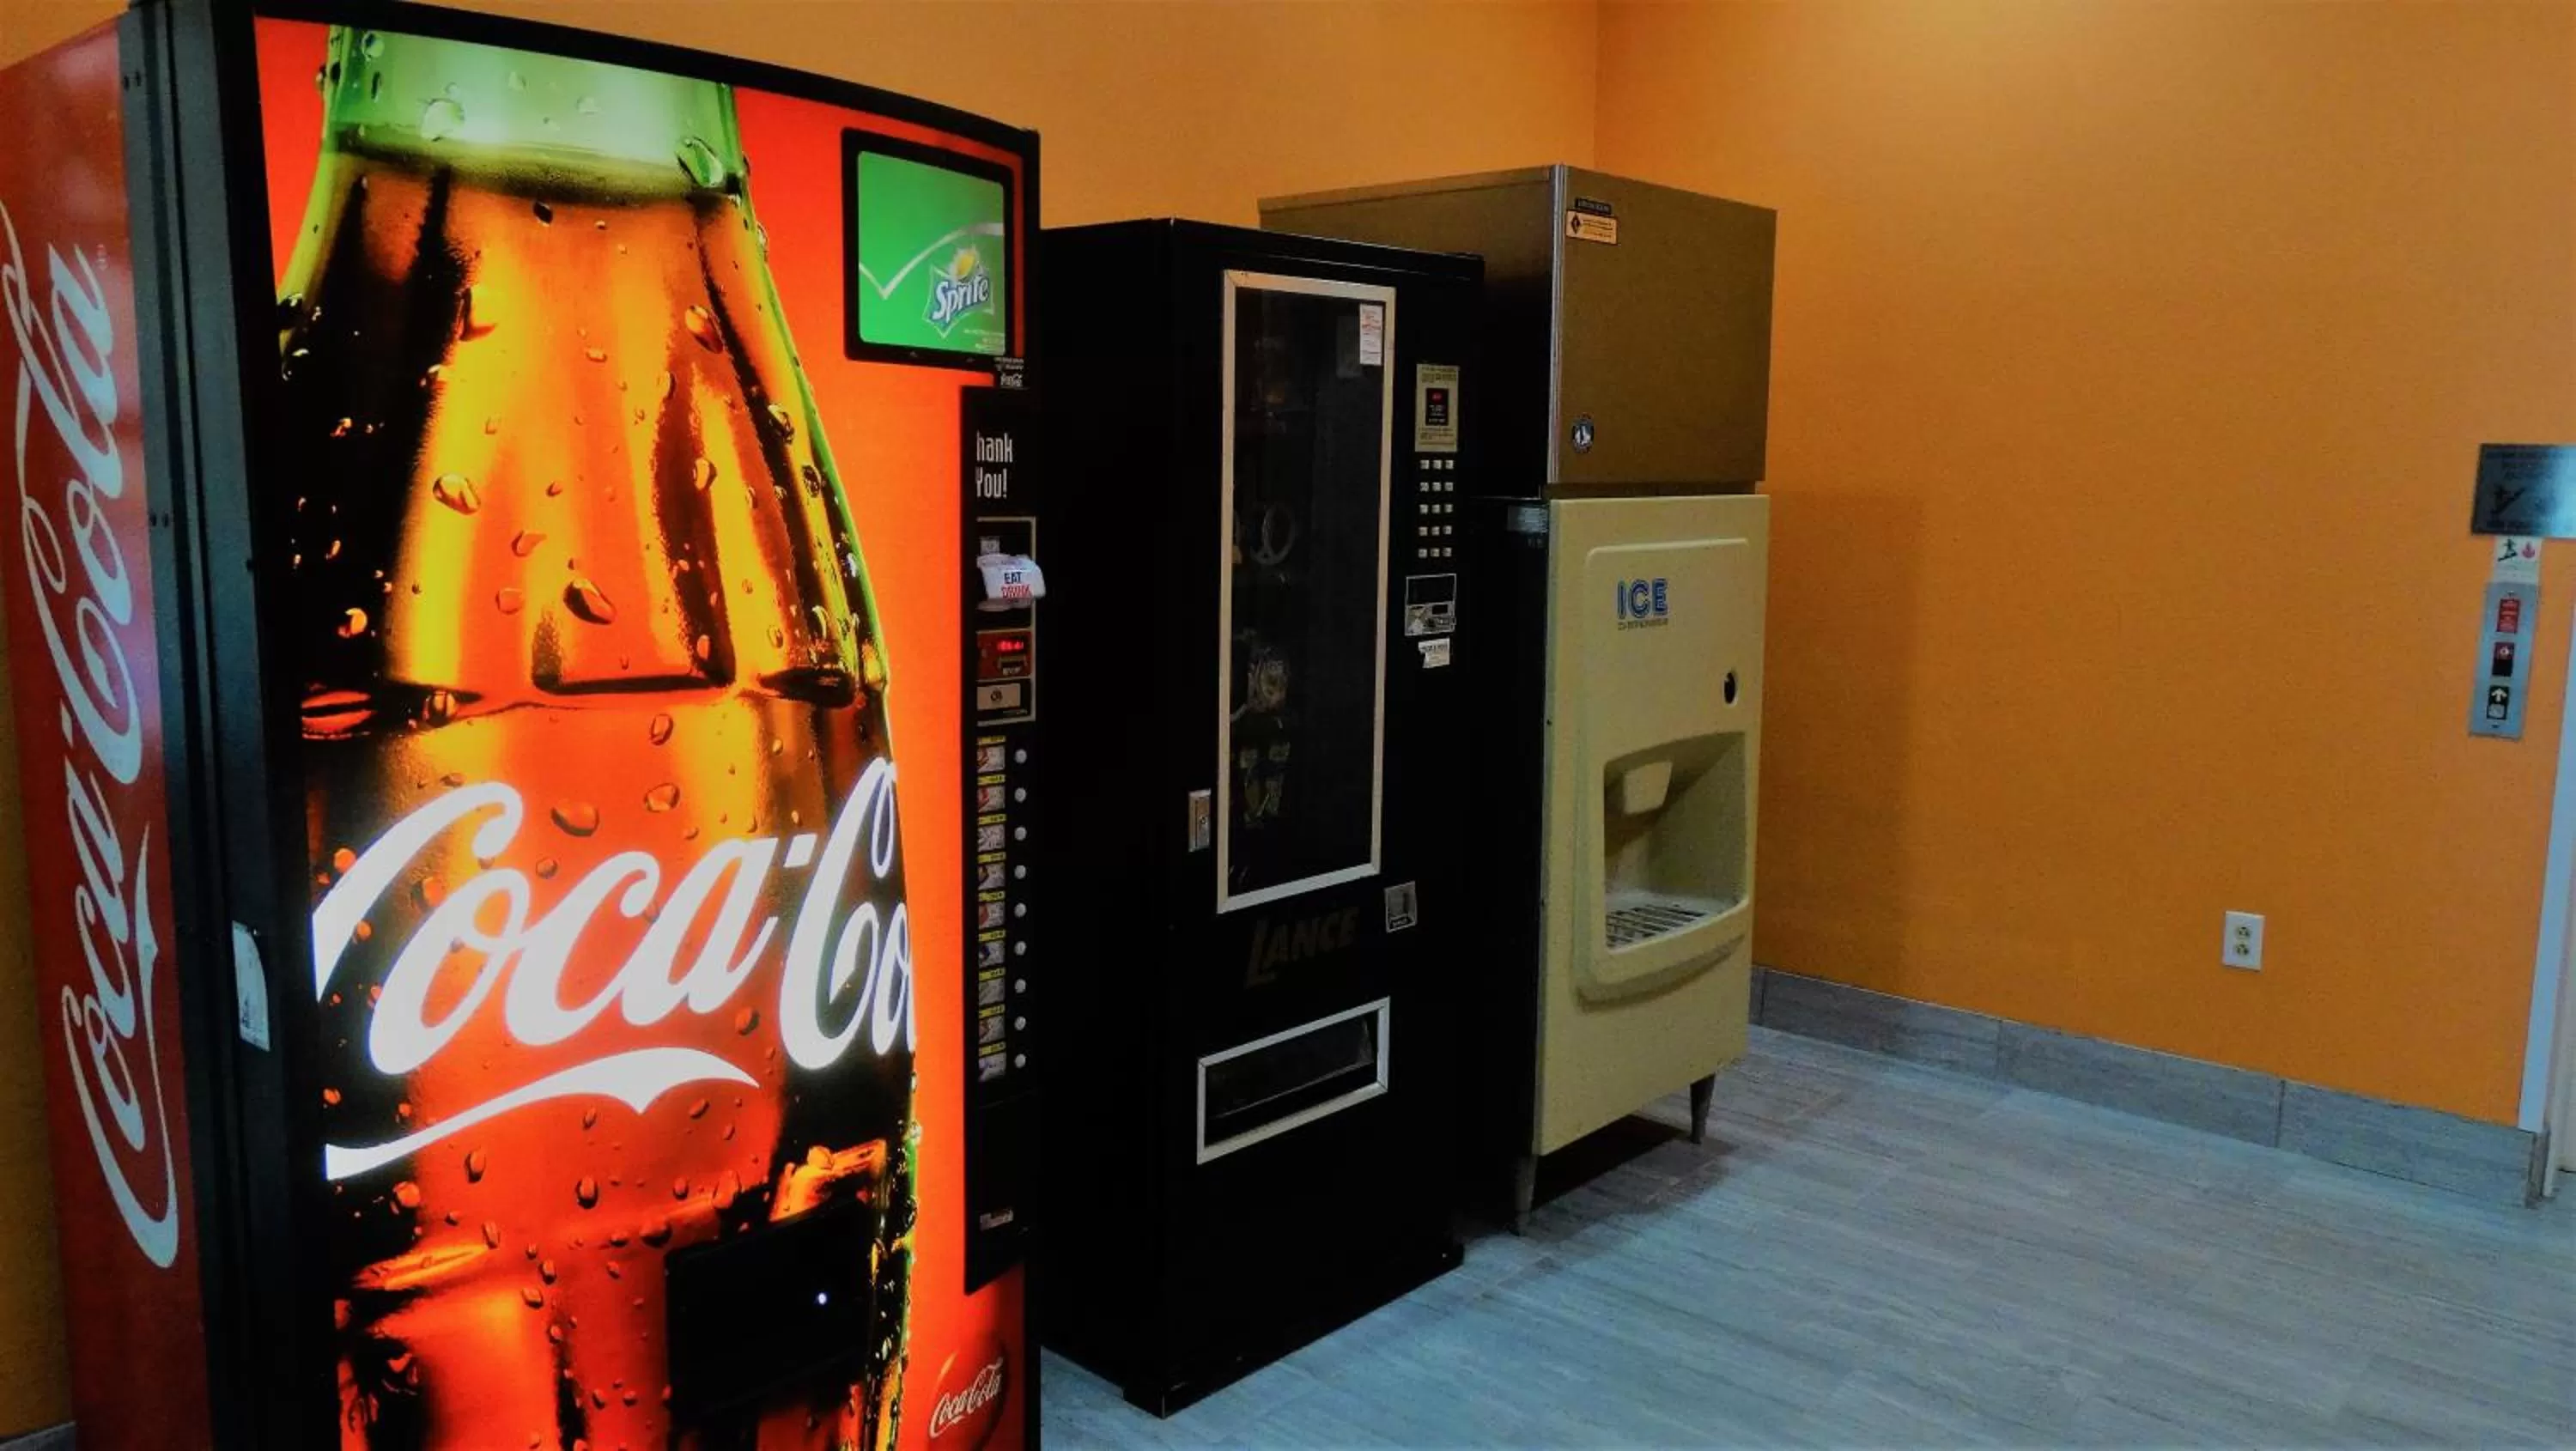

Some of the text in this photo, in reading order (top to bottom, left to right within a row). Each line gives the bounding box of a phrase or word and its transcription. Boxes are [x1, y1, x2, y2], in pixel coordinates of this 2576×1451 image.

[931, 272, 989, 324] Sprite
[975, 430, 1014, 463] hank
[975, 465, 1008, 499] You!
[1004, 571, 1023, 585] EAT
[1617, 577, 1668, 620] ICE
[0, 199, 179, 1269] Coca-Cola
[1243, 904, 1361, 990] LANCE
[929, 1357, 1004, 1439] Coca-Cola
